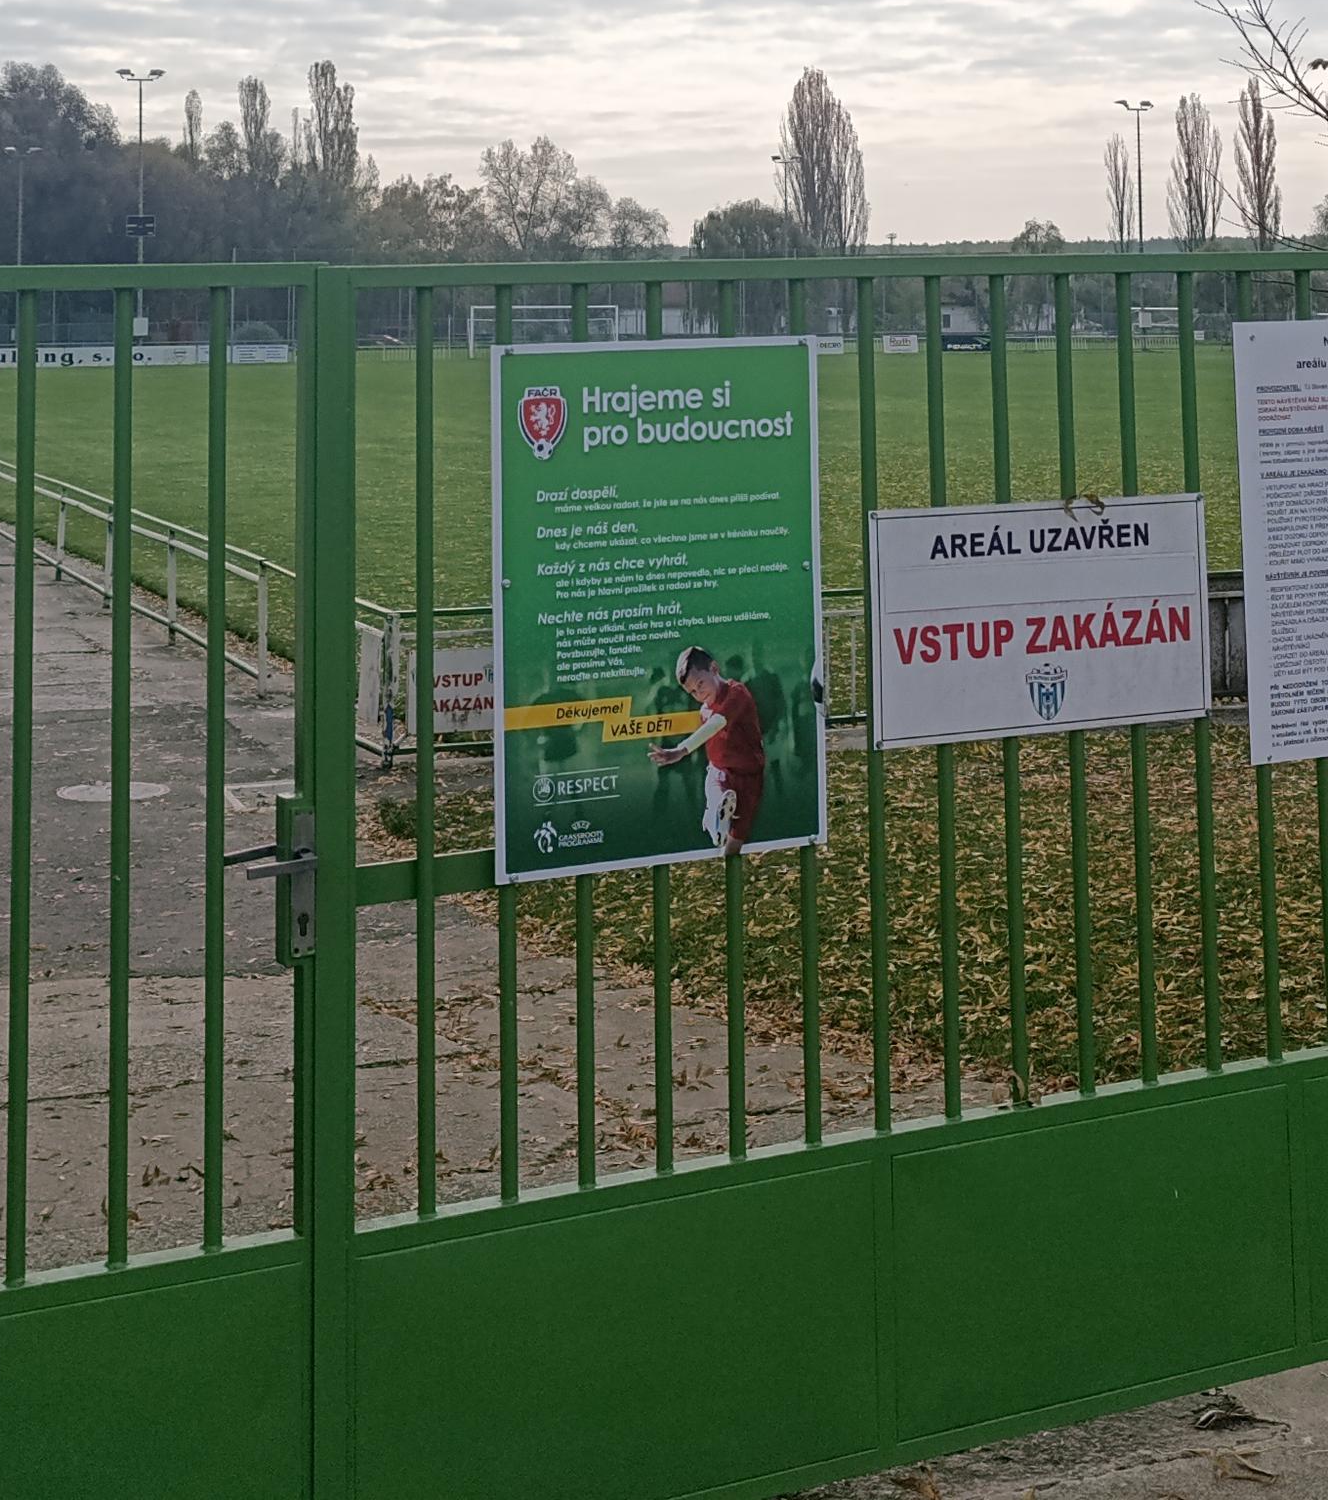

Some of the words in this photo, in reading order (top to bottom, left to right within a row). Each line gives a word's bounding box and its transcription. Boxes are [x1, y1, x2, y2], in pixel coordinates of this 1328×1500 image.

[1295, 356, 1327, 368] areálu
[527, 387, 556, 398] FAČR
[582, 385, 704, 419] Hrajeme
[712, 381, 732, 408] si
[583, 422, 629, 452] pro
[637, 411, 794, 444] budoucnost
[536, 485, 570, 502] Drazí
[571, 483, 618, 503] dospělí,
[554, 502, 582, 513] máme
[584, 500, 612, 511] velkou
[536, 524, 567, 539] Dnes
[569, 522, 582, 539] je
[586, 520, 608, 535] náš
[611, 518, 638, 535] den,
[554, 539, 571, 552] kdy
[572, 537, 607, 549] chceme
[640, 536, 651, 544] co
[652, 530, 687, 544] všechno
[929, 525, 1021, 560] AREÁL
[1029, 518, 1150, 554] UZAVŘEN
[536, 559, 575, 578] Každý
[577, 562, 586, 573] z
[588, 556, 610, 572] nás
[613, 555, 645, 570] chce
[648, 551, 688, 570] vyhrát,
[555, 578, 569, 588] ale
[575, 575, 602, 588] kdyby
[603, 576, 613, 584] se
[614, 573, 633, 583] nám
[635, 572, 644, 582] to
[645, 570, 666, 581] dnes
[555, 589, 569, 599] Pro
[570, 587, 586, 597] nás
[586, 587, 596, 599] je
[598, 584, 623, 595] hlavní
[624, 582, 657, 596] prožitek
[666, 579, 692, 590] radost
[703, 577, 720, 589] hry.
[536, 608, 584, 626] Nechte
[586, 605, 609, 622] nás
[610, 601, 653, 622] prosím
[655, 598, 683, 617] hrát,
[555, 627, 564, 638] je
[565, 626, 574, 635] to
[576, 623, 597, 635] naše
[628, 619, 648, 630] naše
[649, 618, 664, 629] hra
[665, 619, 672, 627] a
[893, 619, 1015, 665] VSTUP
[1025, 599, 1191, 655] ZAKÁZÁN
[555, 636, 571, 648] nás
[572, 635, 596, 646] může
[597, 632, 624, 644] naučit
[625, 631, 647, 642] něco
[555, 660, 570, 671] ale
[571, 657, 606, 671] prosíme
[433, 672, 484, 689] VSTUP
[592, 672, 599, 680] a
[556, 702, 624, 720] Děkujeme!
[610, 718, 645, 737] VAŠE
[646, 716, 672, 733] DĚTI
[557, 775, 618, 796] RESPECT
